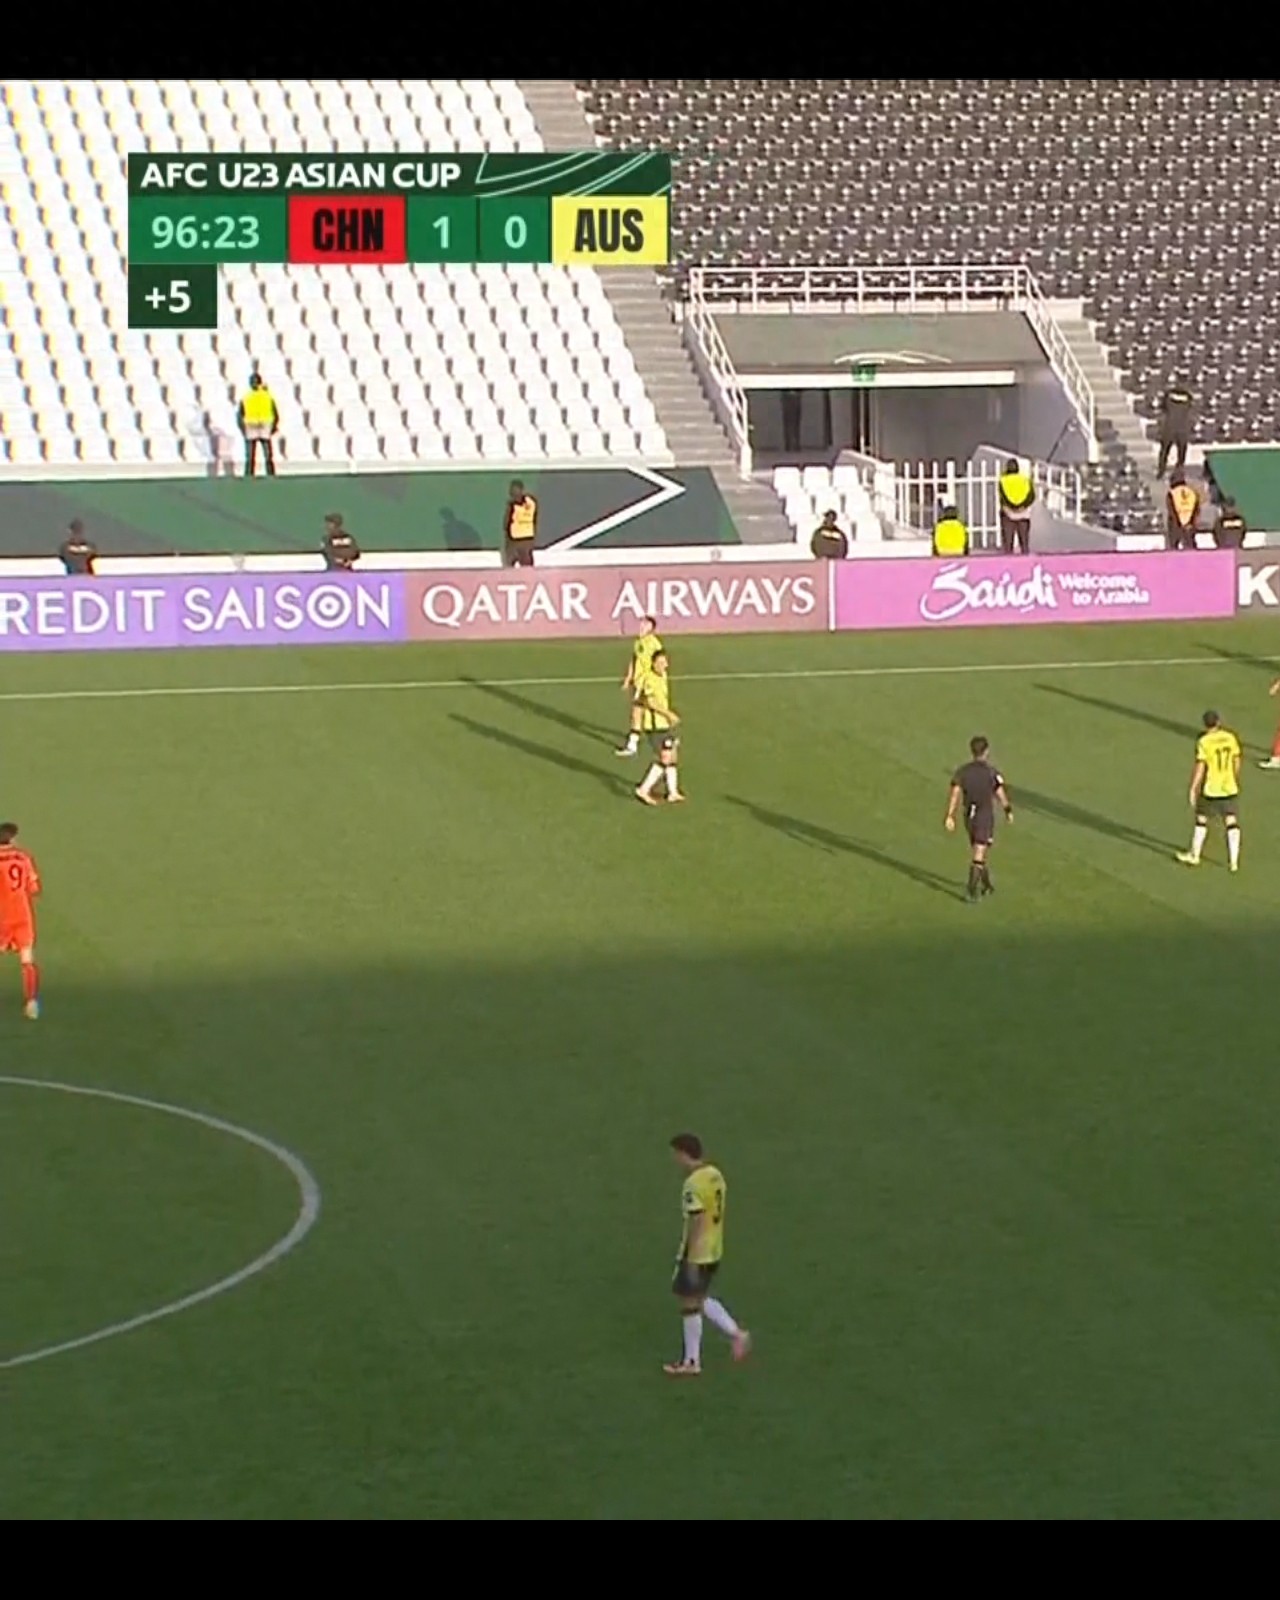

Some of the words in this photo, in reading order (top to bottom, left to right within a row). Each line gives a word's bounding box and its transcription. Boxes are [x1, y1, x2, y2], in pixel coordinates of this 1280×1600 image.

[1058, 572, 1138, 591] Welcome
[182, 584, 391, 632] SAISON
[422, 582, 592, 628] QATAR
[611, 577, 815, 619] AIRWAYS
[1072, 588, 1092, 606] to
[1093, 587, 1150, 605] Arabia
[1215, 746, 1231, 771] 17
[8, 863, 22, 891] 9
